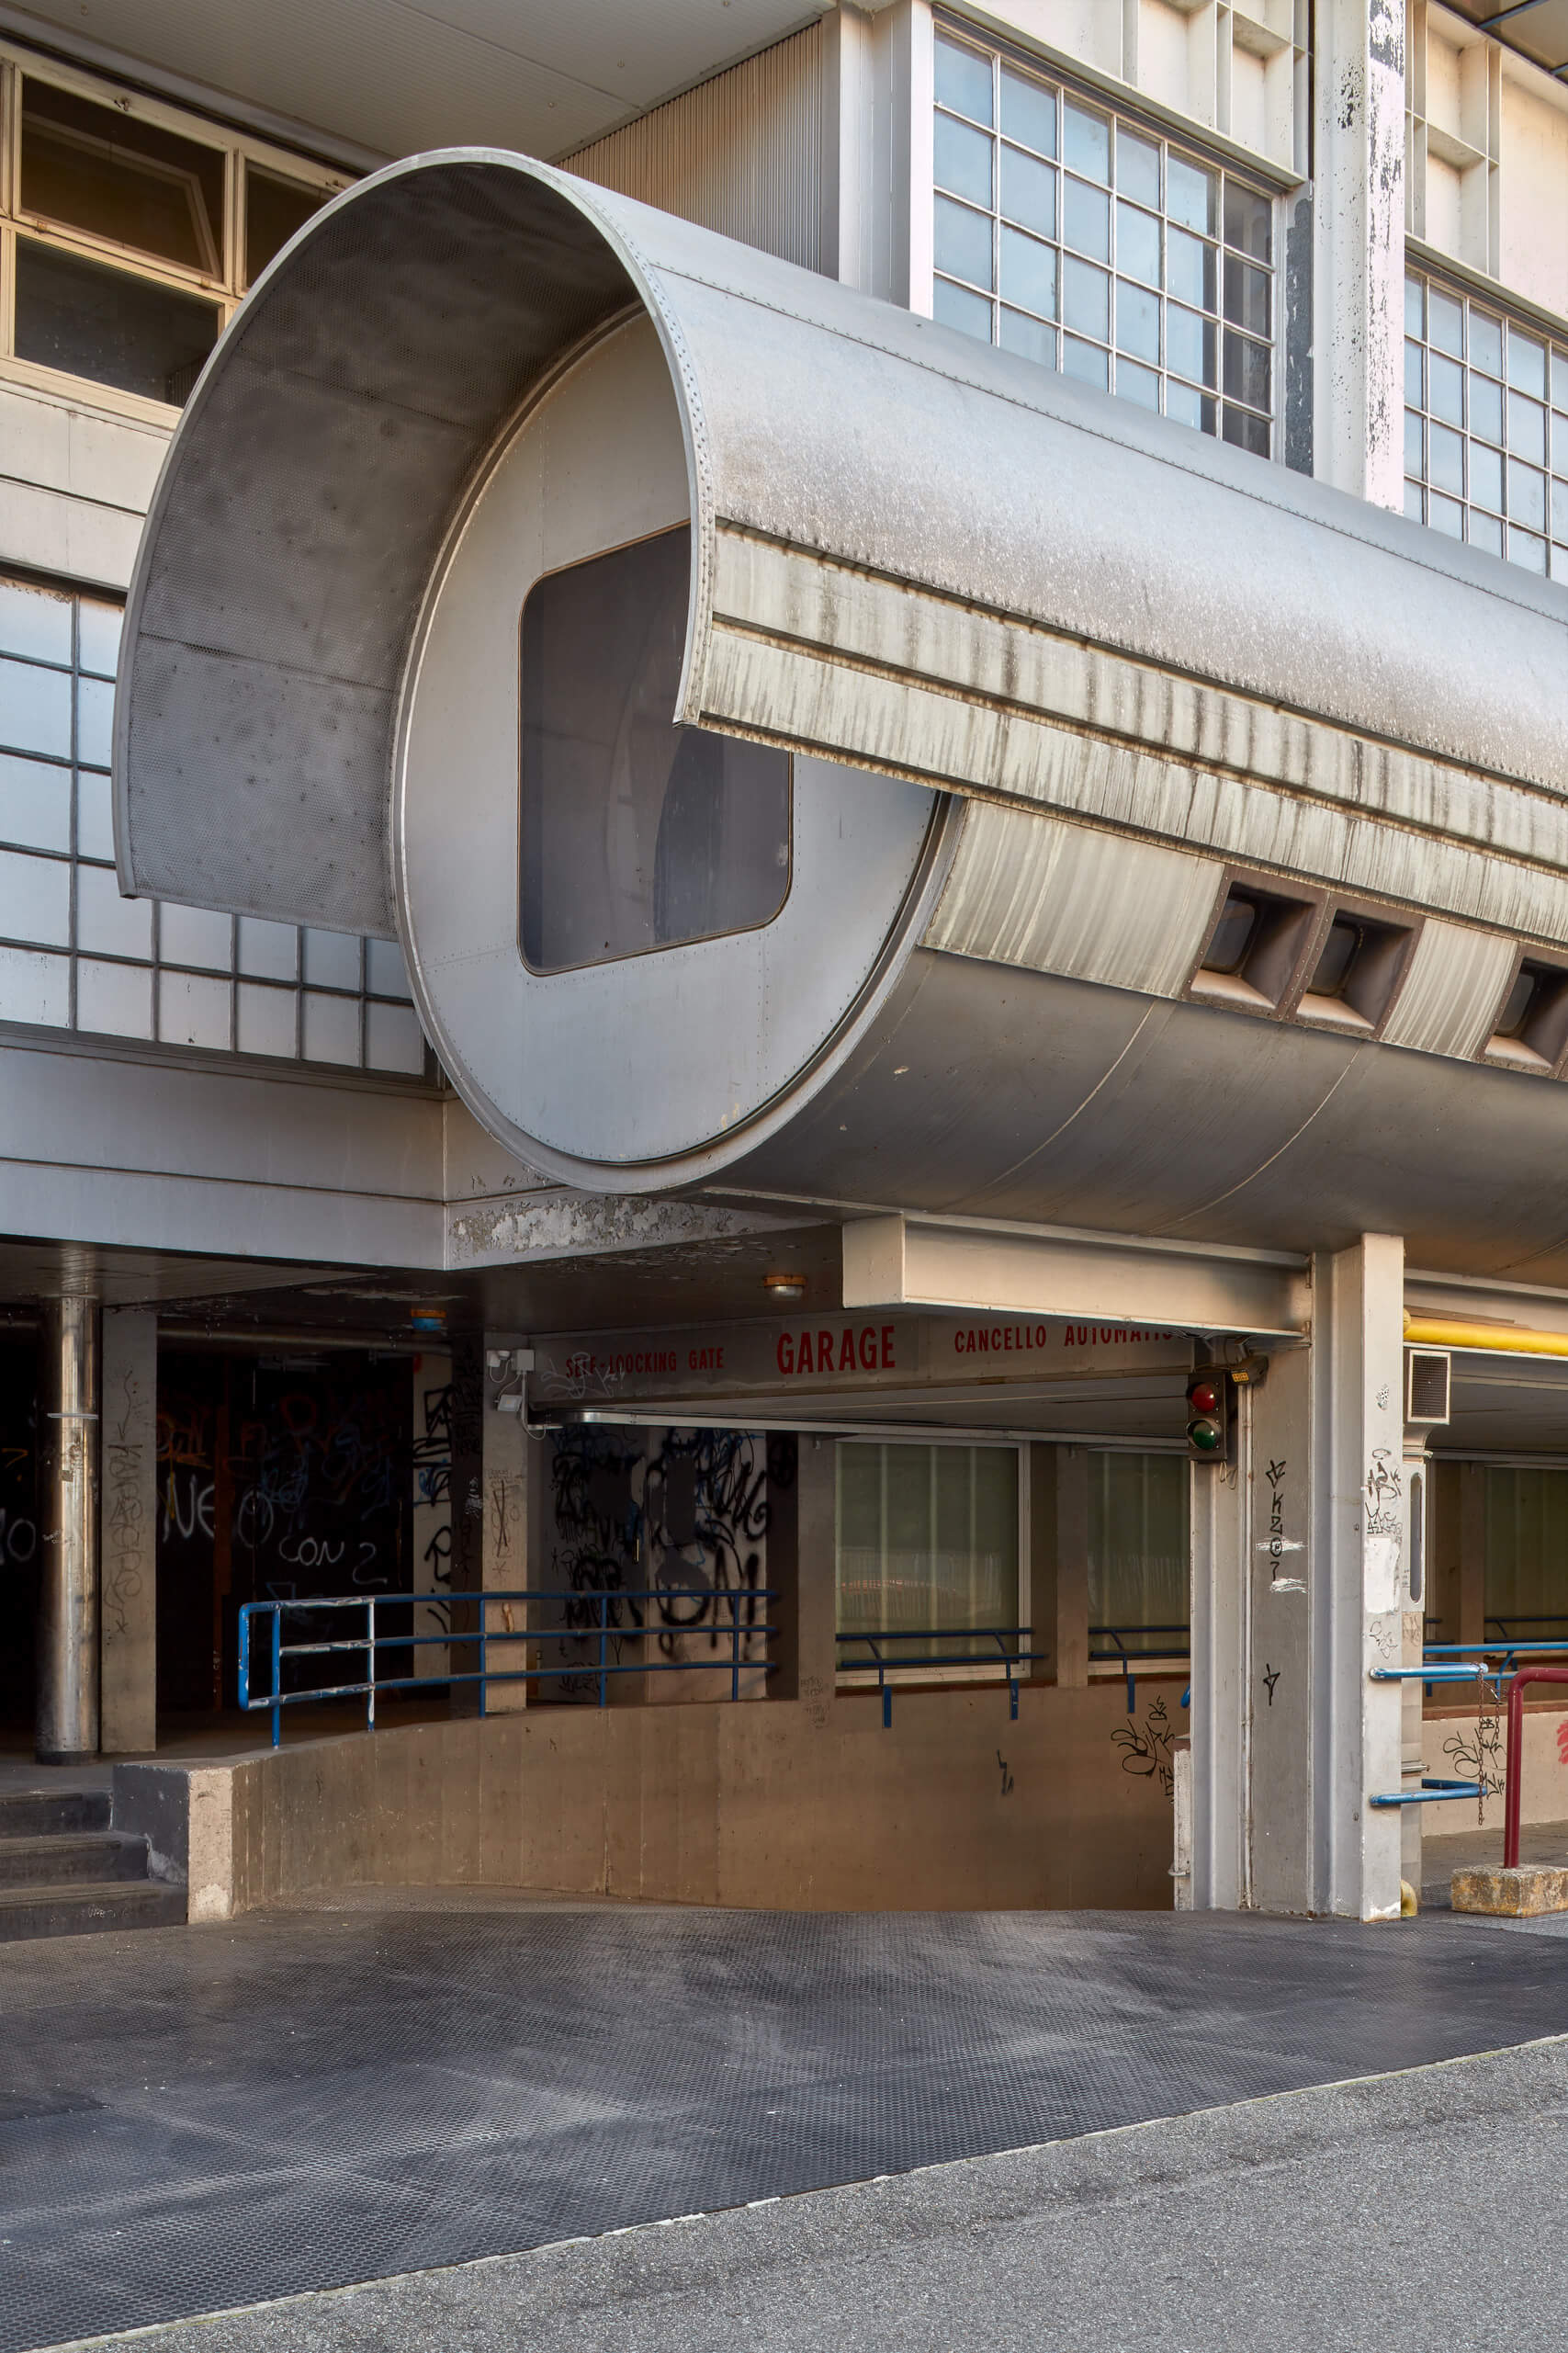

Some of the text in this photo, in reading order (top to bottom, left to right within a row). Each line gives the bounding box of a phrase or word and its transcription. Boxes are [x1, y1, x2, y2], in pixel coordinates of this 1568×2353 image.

[776, 1325, 897, 1375] GARAGE
[954, 1325, 1047, 1353] CANCELLO
[687, 1347, 724, 1371] GATE
